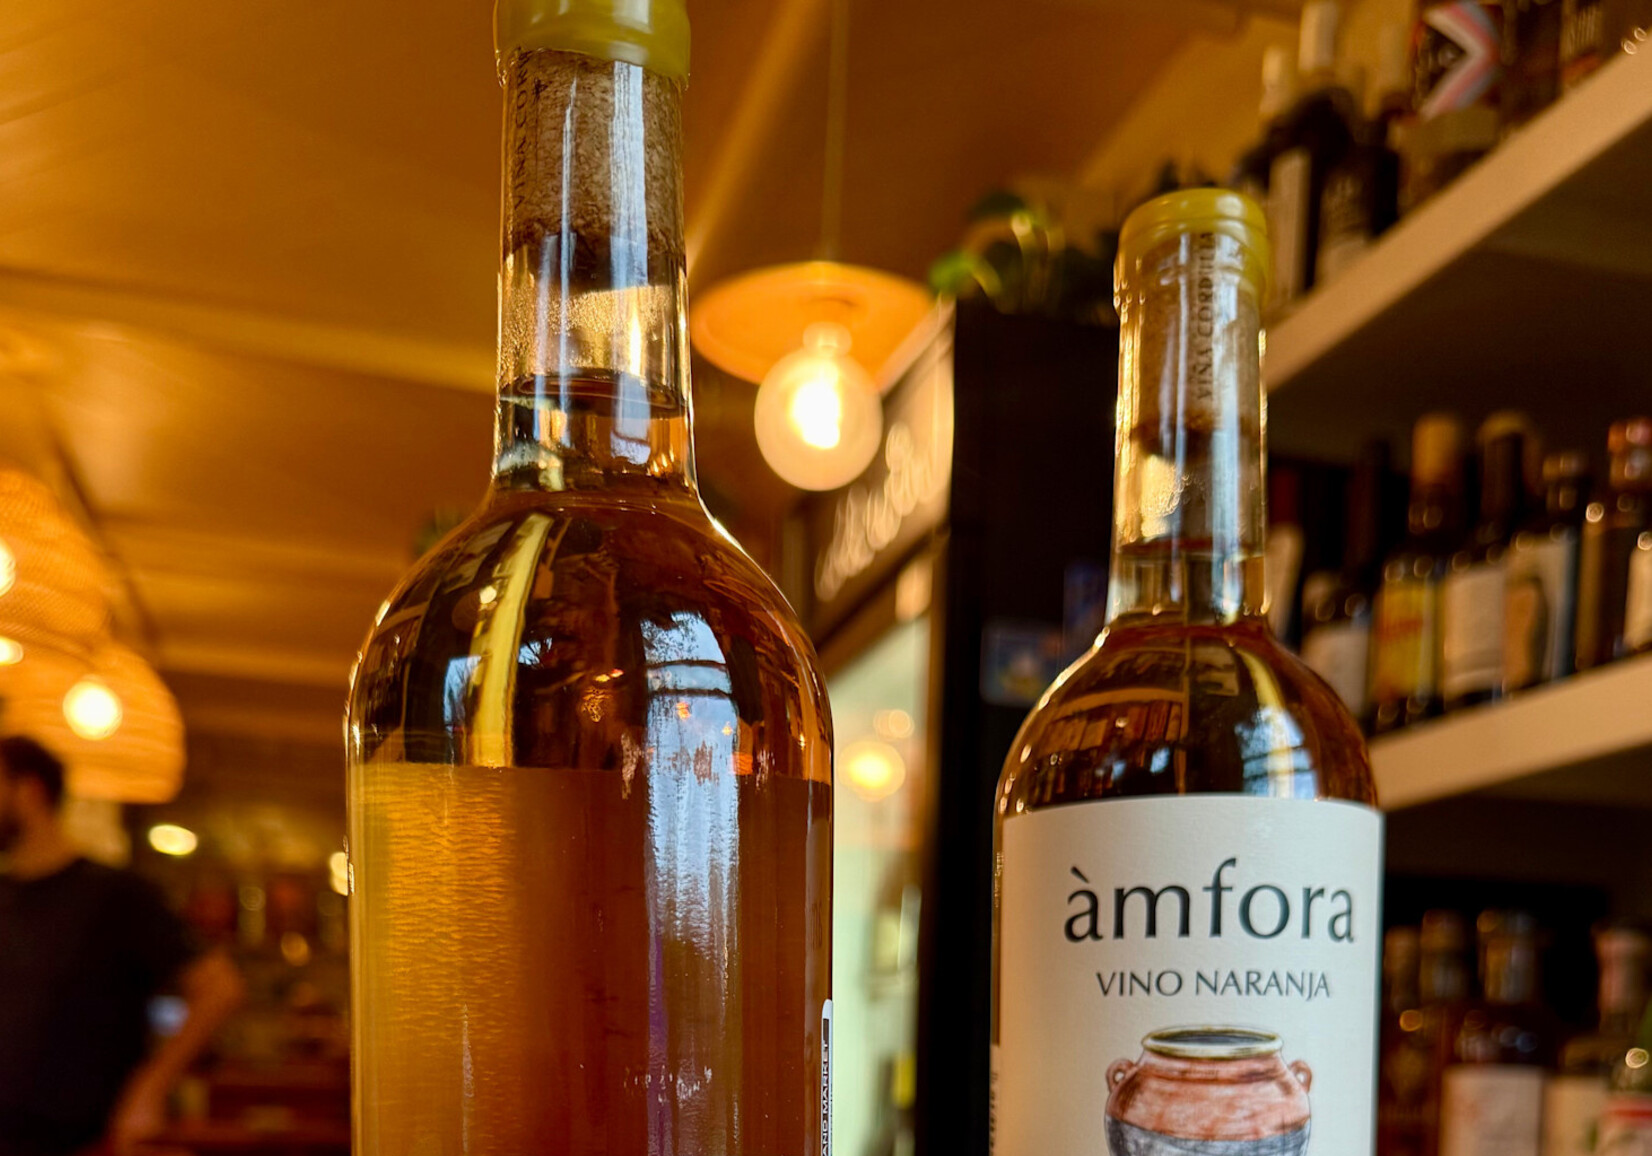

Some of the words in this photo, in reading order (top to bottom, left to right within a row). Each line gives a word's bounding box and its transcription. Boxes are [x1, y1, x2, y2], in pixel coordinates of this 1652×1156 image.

[1063, 857, 1355, 944] àmfora
[1096, 970, 1183, 997] VINO
[1196, 970, 1331, 1001] NARANJA
